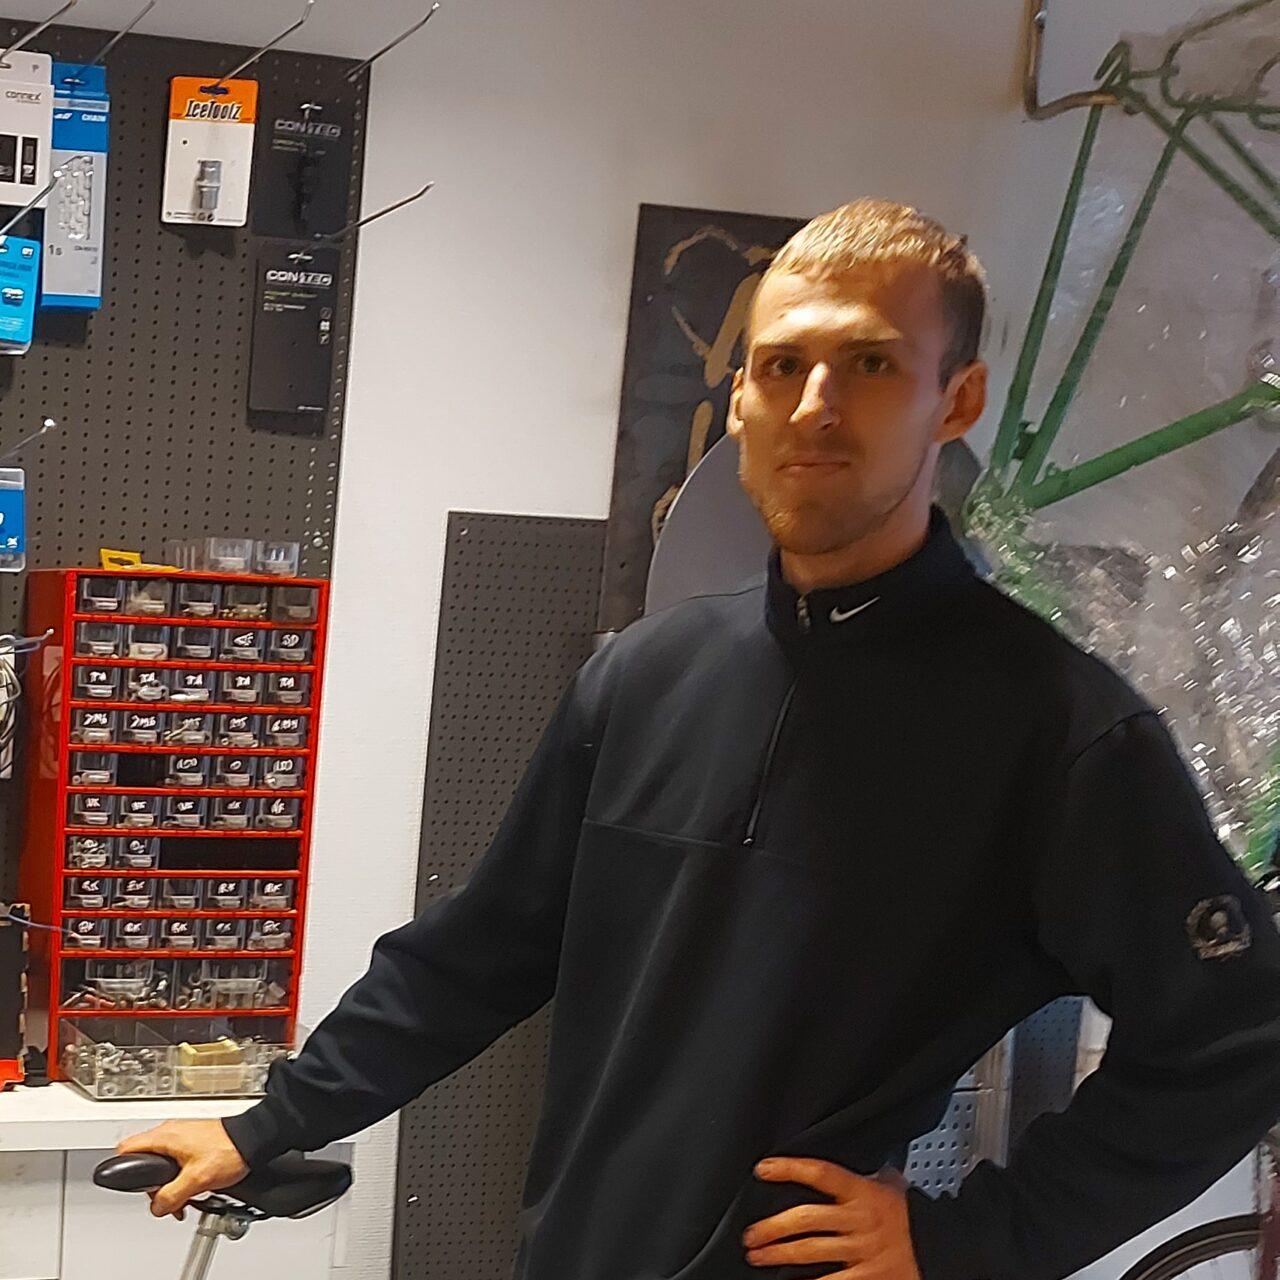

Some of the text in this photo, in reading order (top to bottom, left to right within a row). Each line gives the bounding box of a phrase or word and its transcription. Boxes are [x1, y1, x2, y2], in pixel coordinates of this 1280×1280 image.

[5, 90, 41, 102] connex
[185, 99, 244, 121] IceToolz
[274, 118, 342, 138] CONTEC
[266, 270, 333, 286] CONTEC
